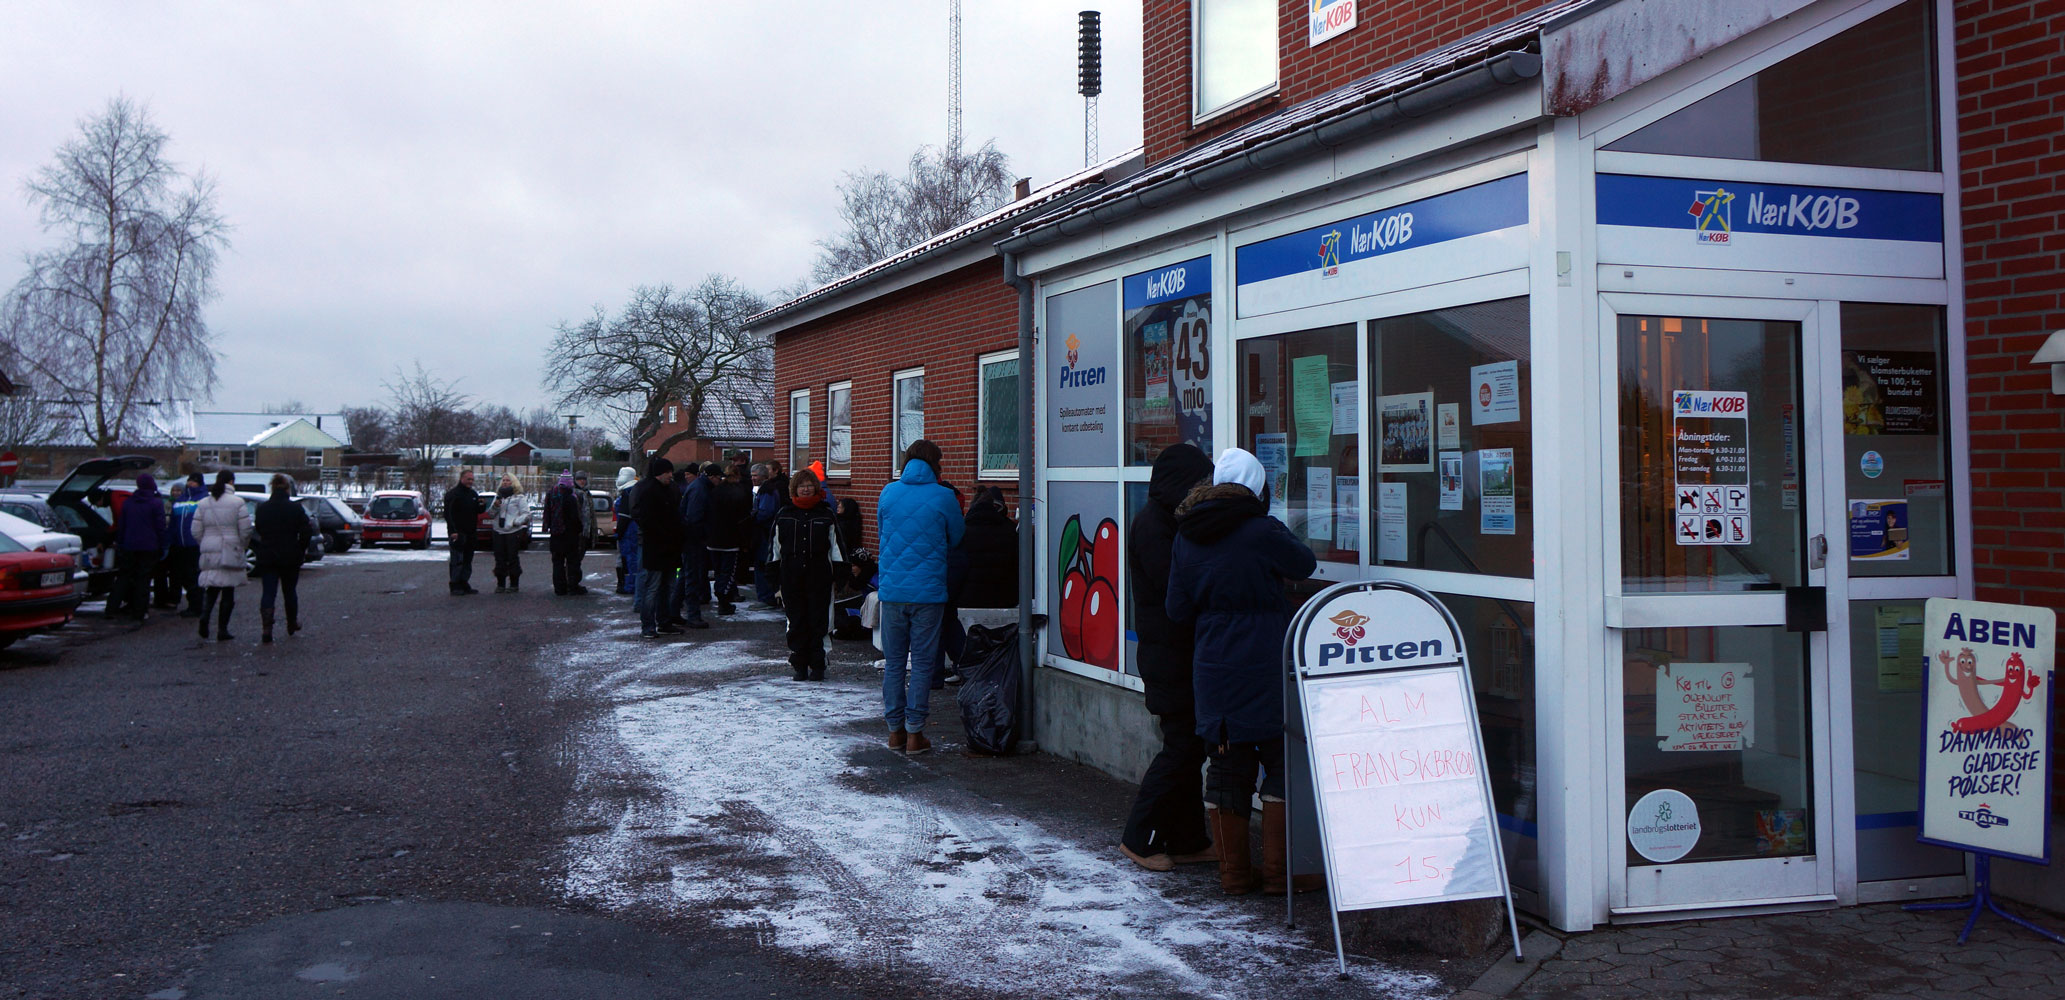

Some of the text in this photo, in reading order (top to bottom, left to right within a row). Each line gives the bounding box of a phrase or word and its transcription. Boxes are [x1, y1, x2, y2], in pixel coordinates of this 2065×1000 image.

[1312, 1, 1353, 38] NærKØB
[1748, 191, 1860, 231] NærKØB
[1350, 212, 1414, 255] NærKØB
[1698, 232, 1729, 242] NærKØB
[1147, 267, 1186, 300] NærKØB
[1176, 318, 1210, 381] 43
[1858, 355, 1891, 366] Vi sælger
[1060, 366, 1105, 388] Pitten
[1870, 366, 1933, 376] blomsterbuketter
[1878, 376, 1922, 387] fra 100,- kr.
[1183, 382, 1204, 410] mio
[1887, 386, 1923, 396] bundet af
[1095, 404, 1106, 415] med
[1693, 396, 1746, 414] NærKØB
[1062, 420, 1104, 433] kontant udbetaling
[1678, 429, 1731, 444] Åbningstider:
[1678, 446, 1715, 455] Man-torsdag
[1678, 456, 1699, 464] Fredag
[1678, 465, 1711, 473] Lør-søndag
[1943, 612, 2036, 649] ÅBEN
[1318, 638, 1442, 667] Pitten
[1360, 692, 1427, 723] ALM
[1678, 713, 1729, 721] STARTER
[1939, 728, 2034, 754] DANMARKS
[1331, 750, 1476, 790] FRANSKBRØD
[1963, 750, 2040, 775] GLADESTE
[1948, 773, 2022, 798] PØLSER!
[1394, 803, 1442, 831] KUN
[1631, 822, 1697, 835] landbrugslotteriet
